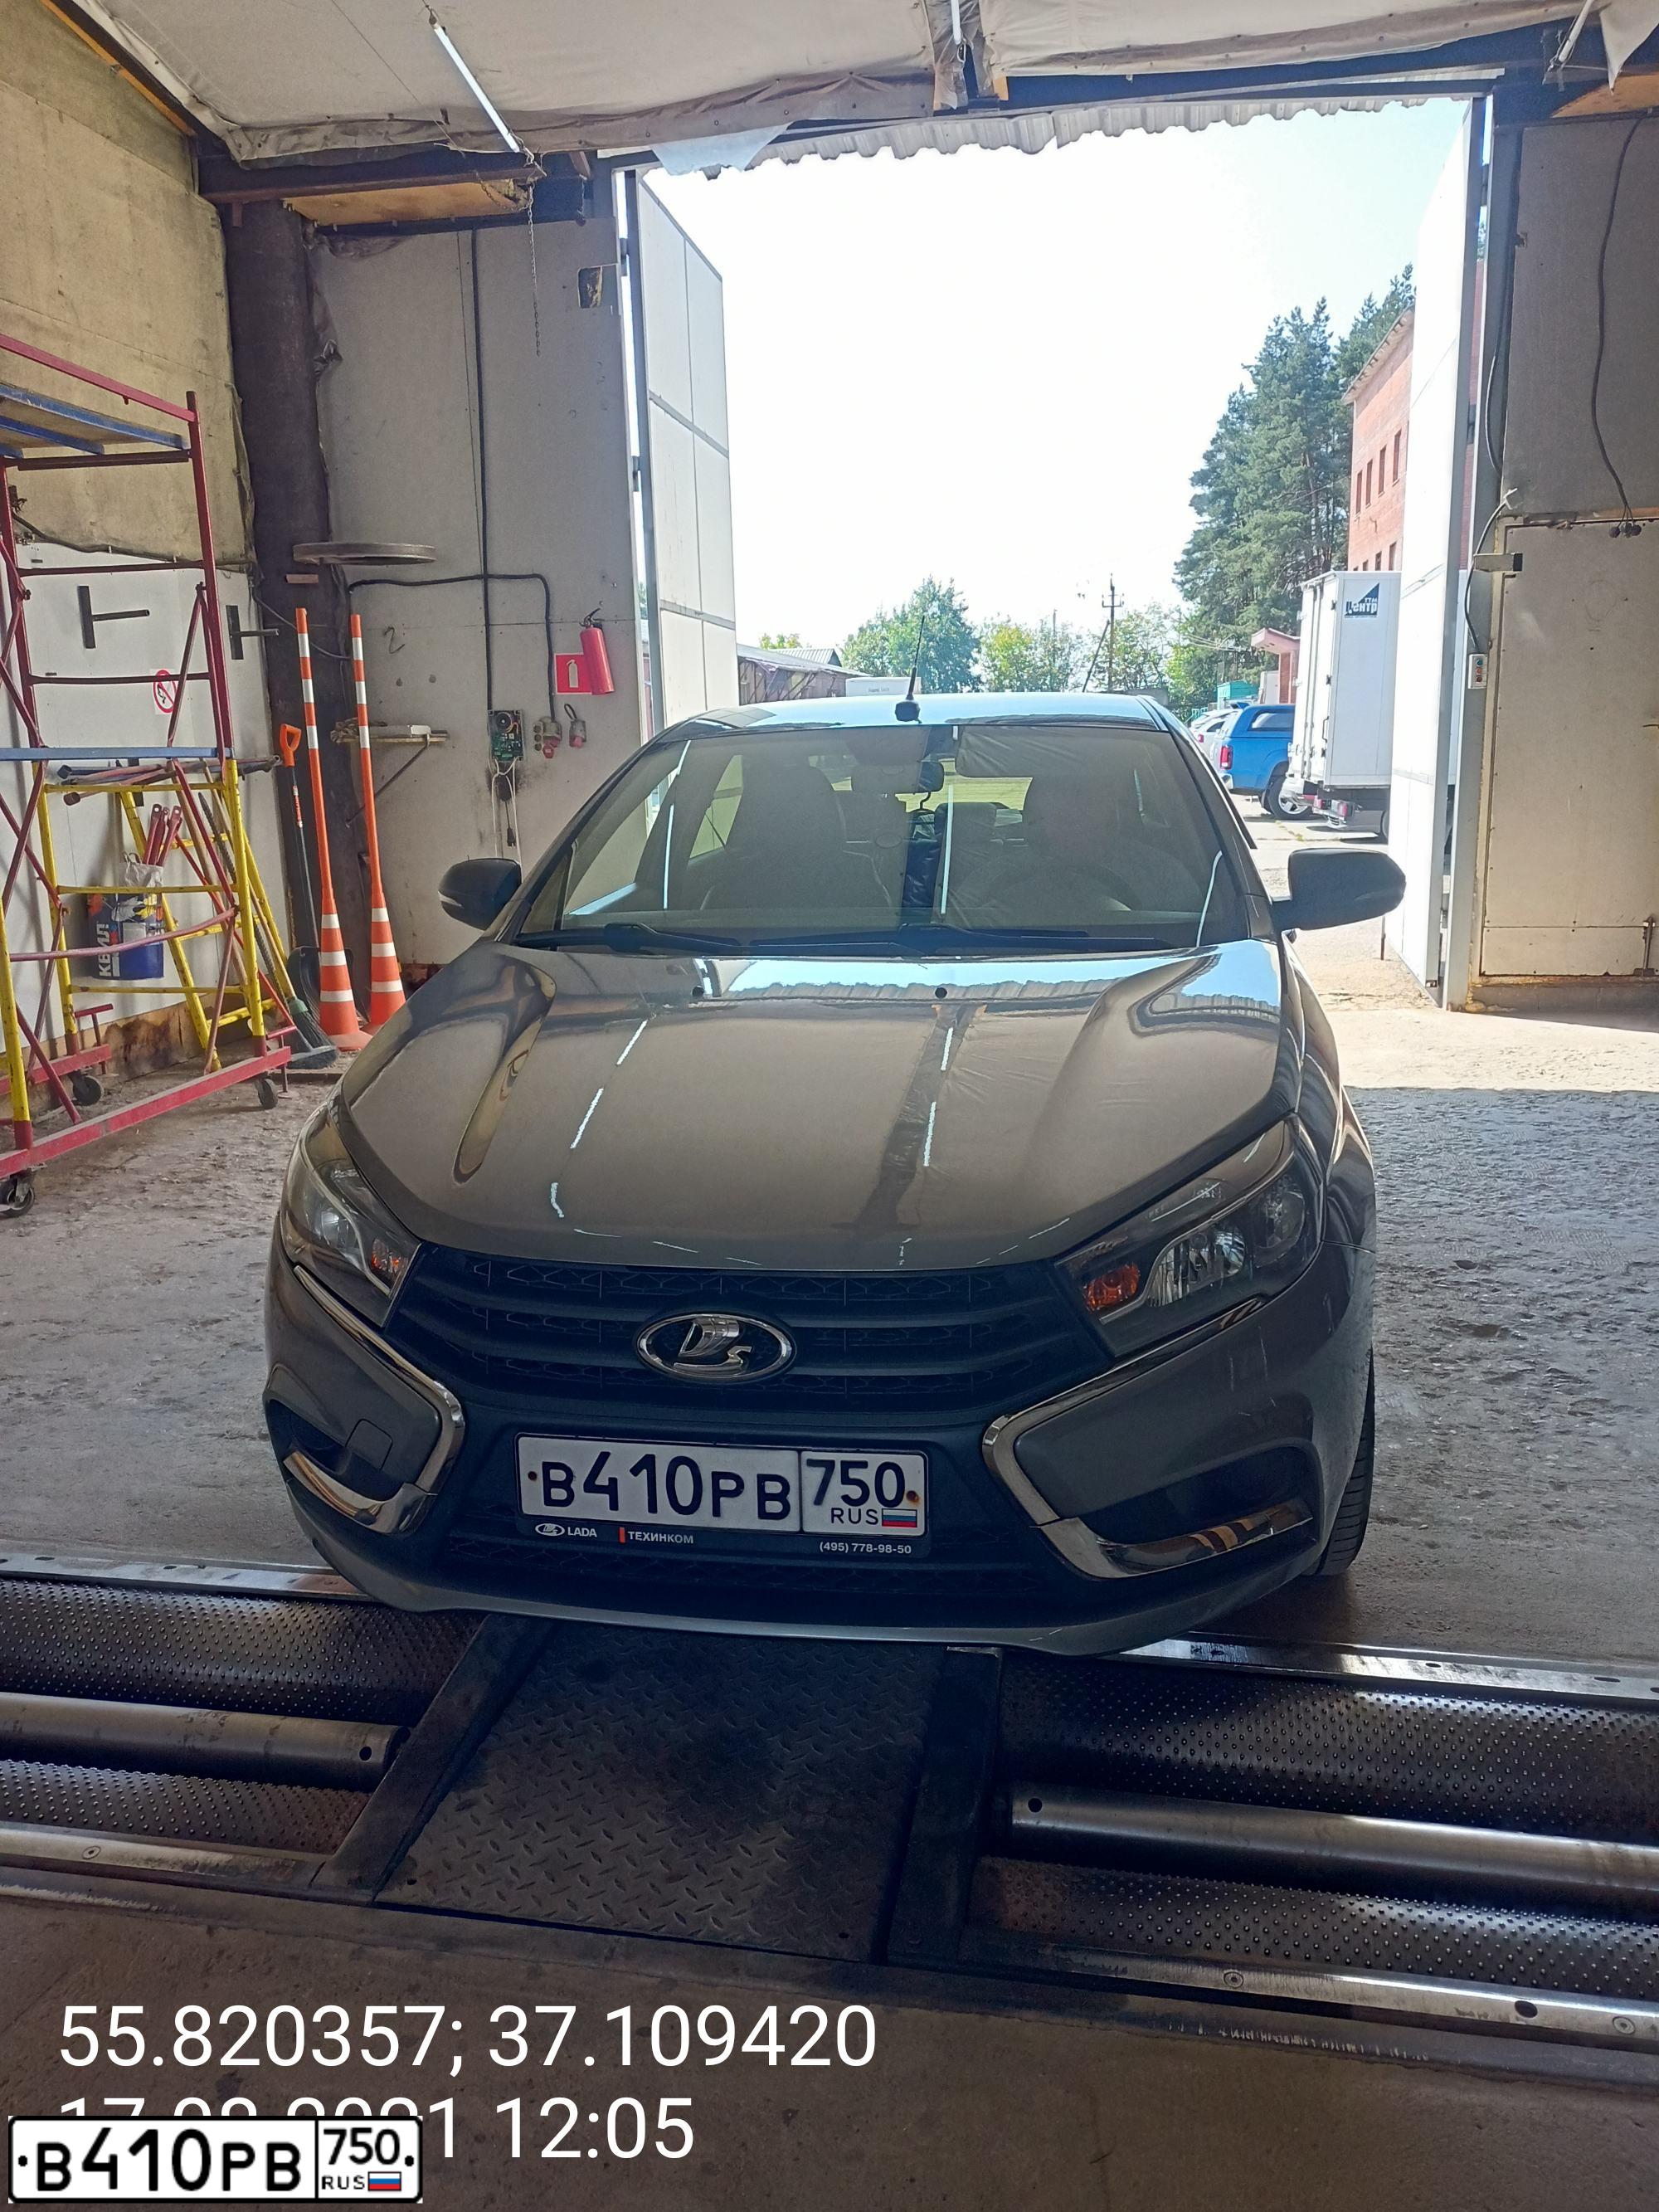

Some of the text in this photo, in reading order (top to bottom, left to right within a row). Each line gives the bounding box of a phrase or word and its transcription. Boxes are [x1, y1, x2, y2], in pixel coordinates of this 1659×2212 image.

[541, 1450, 906, 1521] В410РВ 750
[830, 1508, 878, 1525] RUS
[567, 1527, 597, 1537] LADA
[627, 1531, 694, 1544] ТЕХИНКОМ
[820, 1542, 912, 1554] (495) 778-98-50
